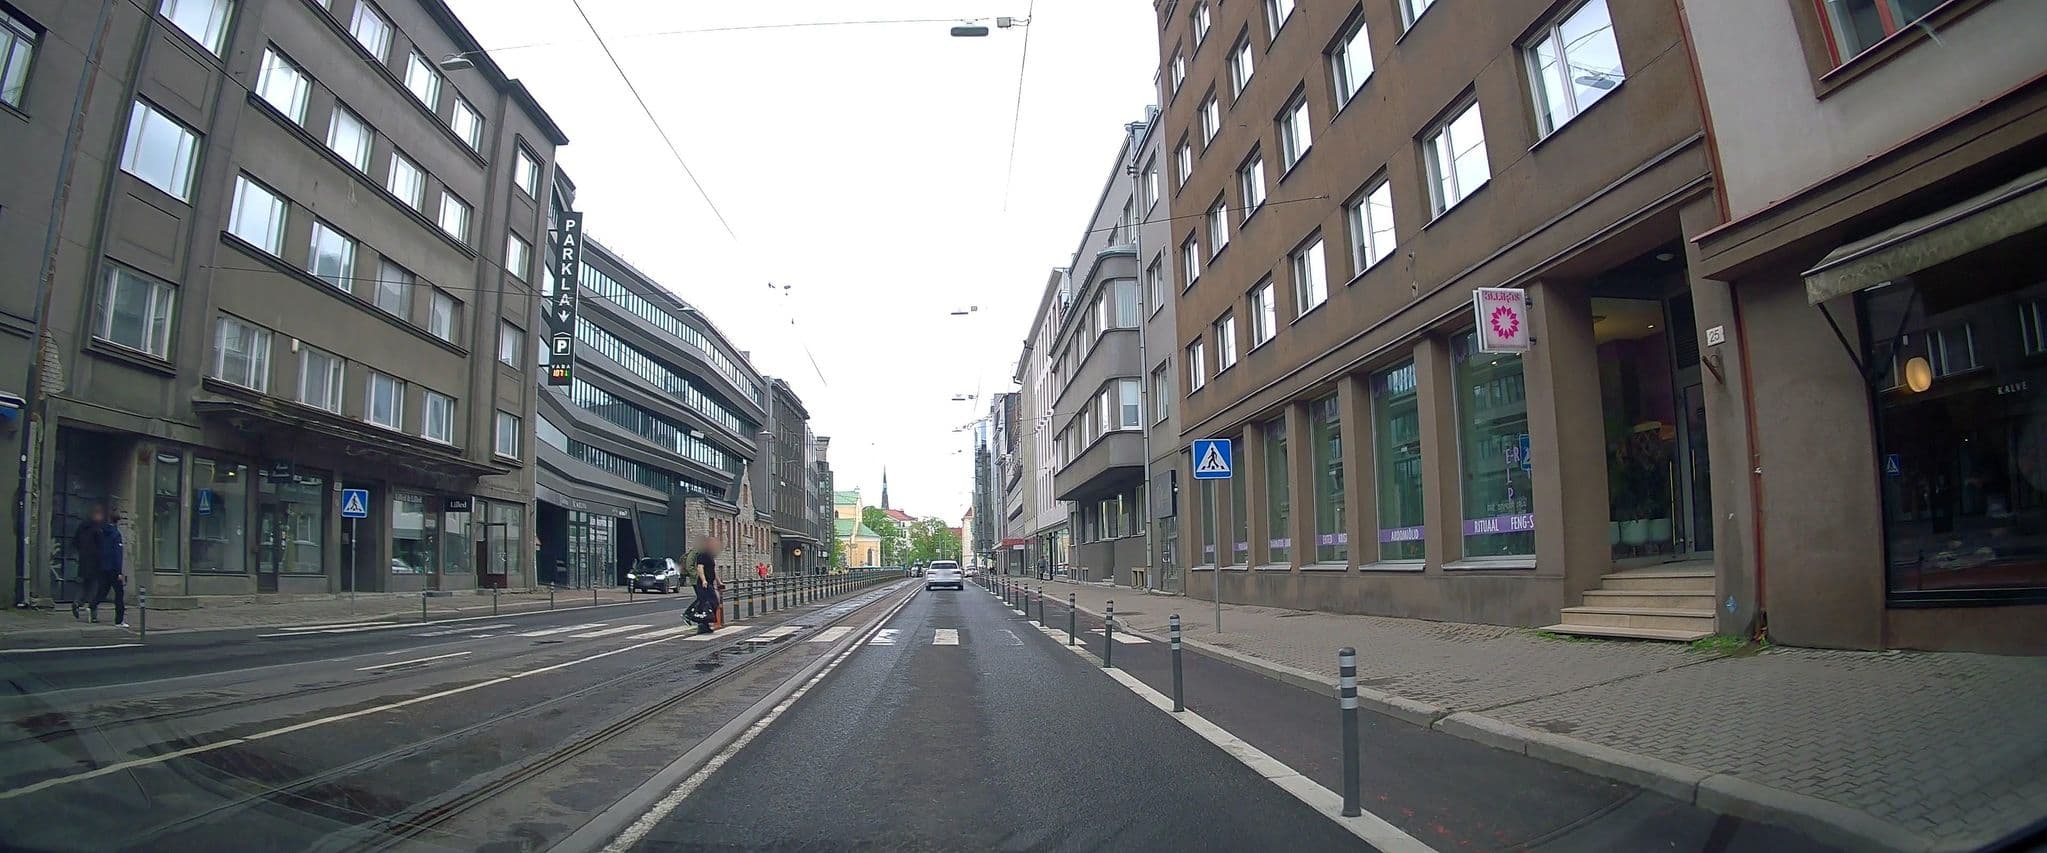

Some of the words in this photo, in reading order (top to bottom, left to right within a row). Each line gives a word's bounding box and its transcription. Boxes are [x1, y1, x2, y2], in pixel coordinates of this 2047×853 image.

[558, 219, 576, 307] PARKLA
[1709, 329, 1720, 342] 25
[557, 341, 567, 352] P
[1474, 519, 1500, 533] RITUAAL
